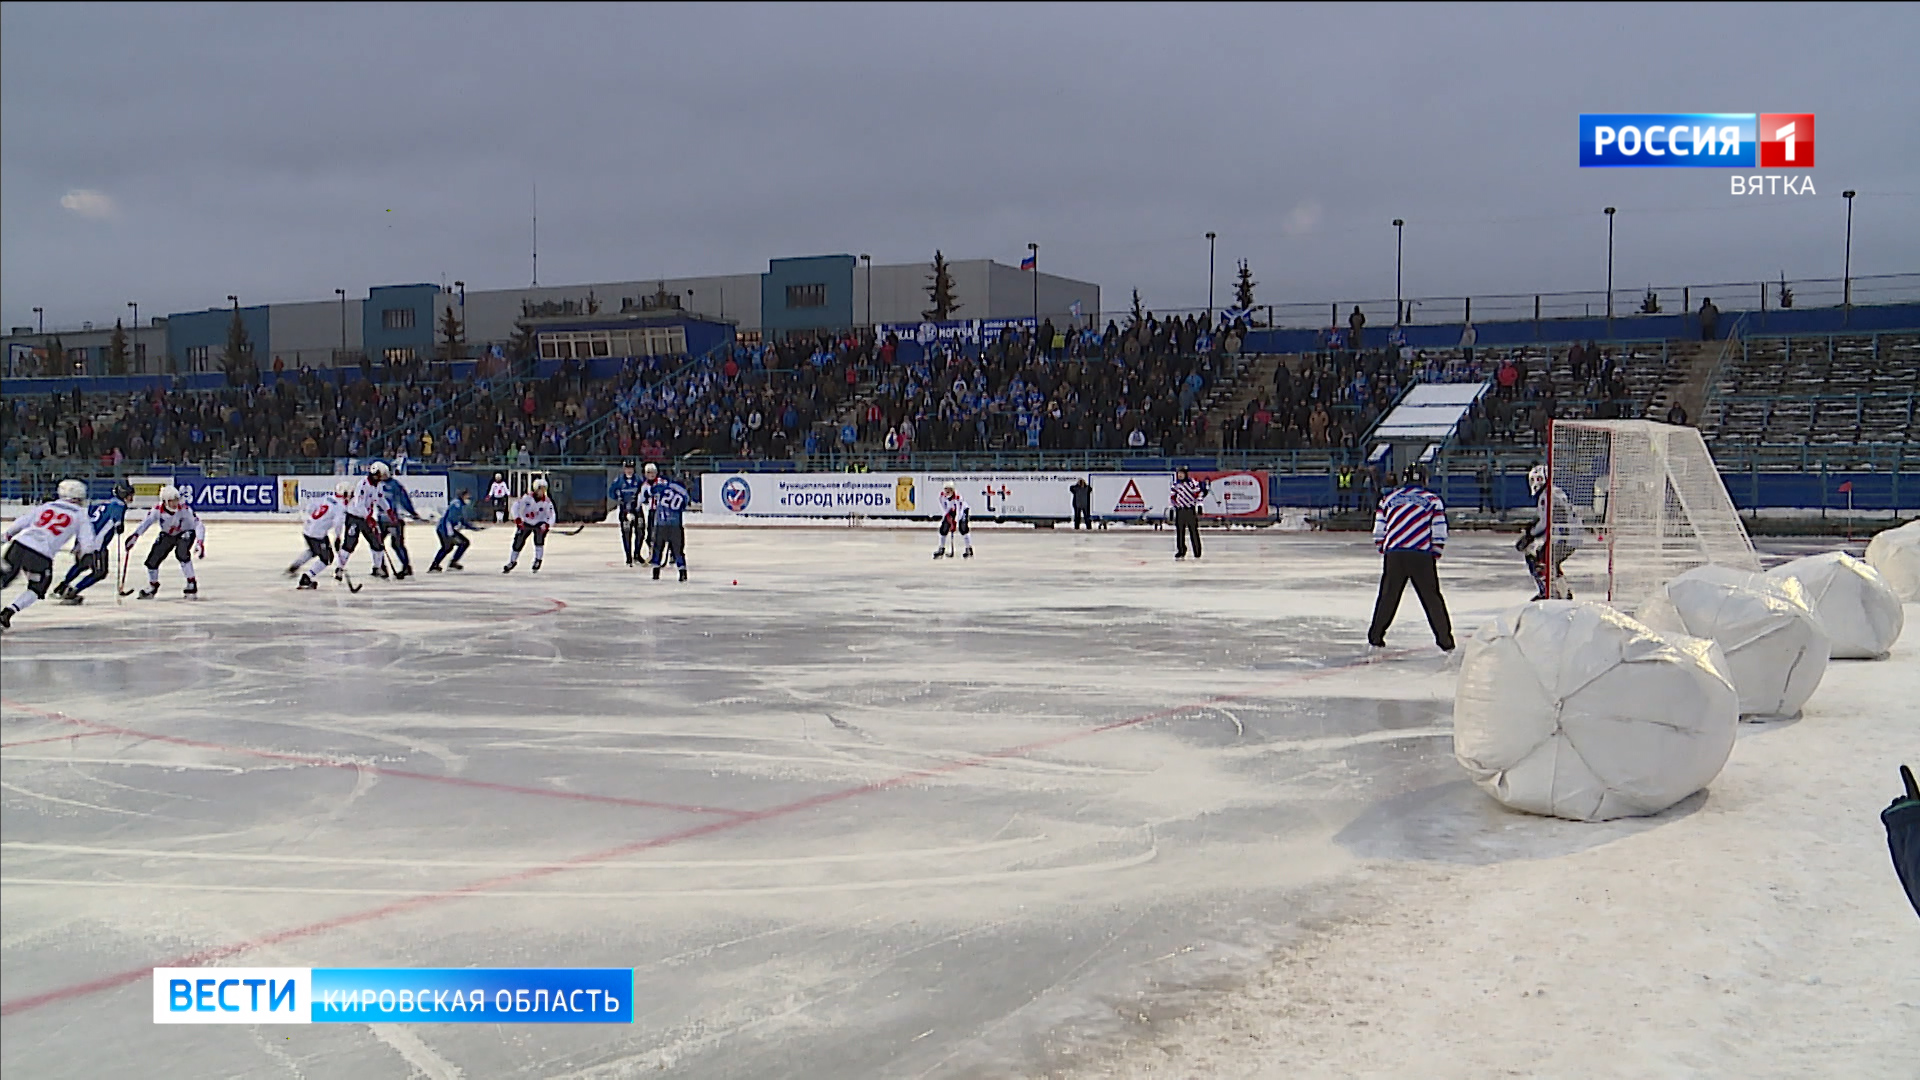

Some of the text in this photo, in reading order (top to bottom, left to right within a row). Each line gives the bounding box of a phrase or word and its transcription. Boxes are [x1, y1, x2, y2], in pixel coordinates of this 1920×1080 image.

[196, 484, 274, 505] ЛЕПСЕ
[300, 489, 336, 499] Правите
[660, 489, 683, 510] 20
[780, 493, 891, 508] «ГОРОД КИРОВ»
[35, 508, 71, 536] 92
